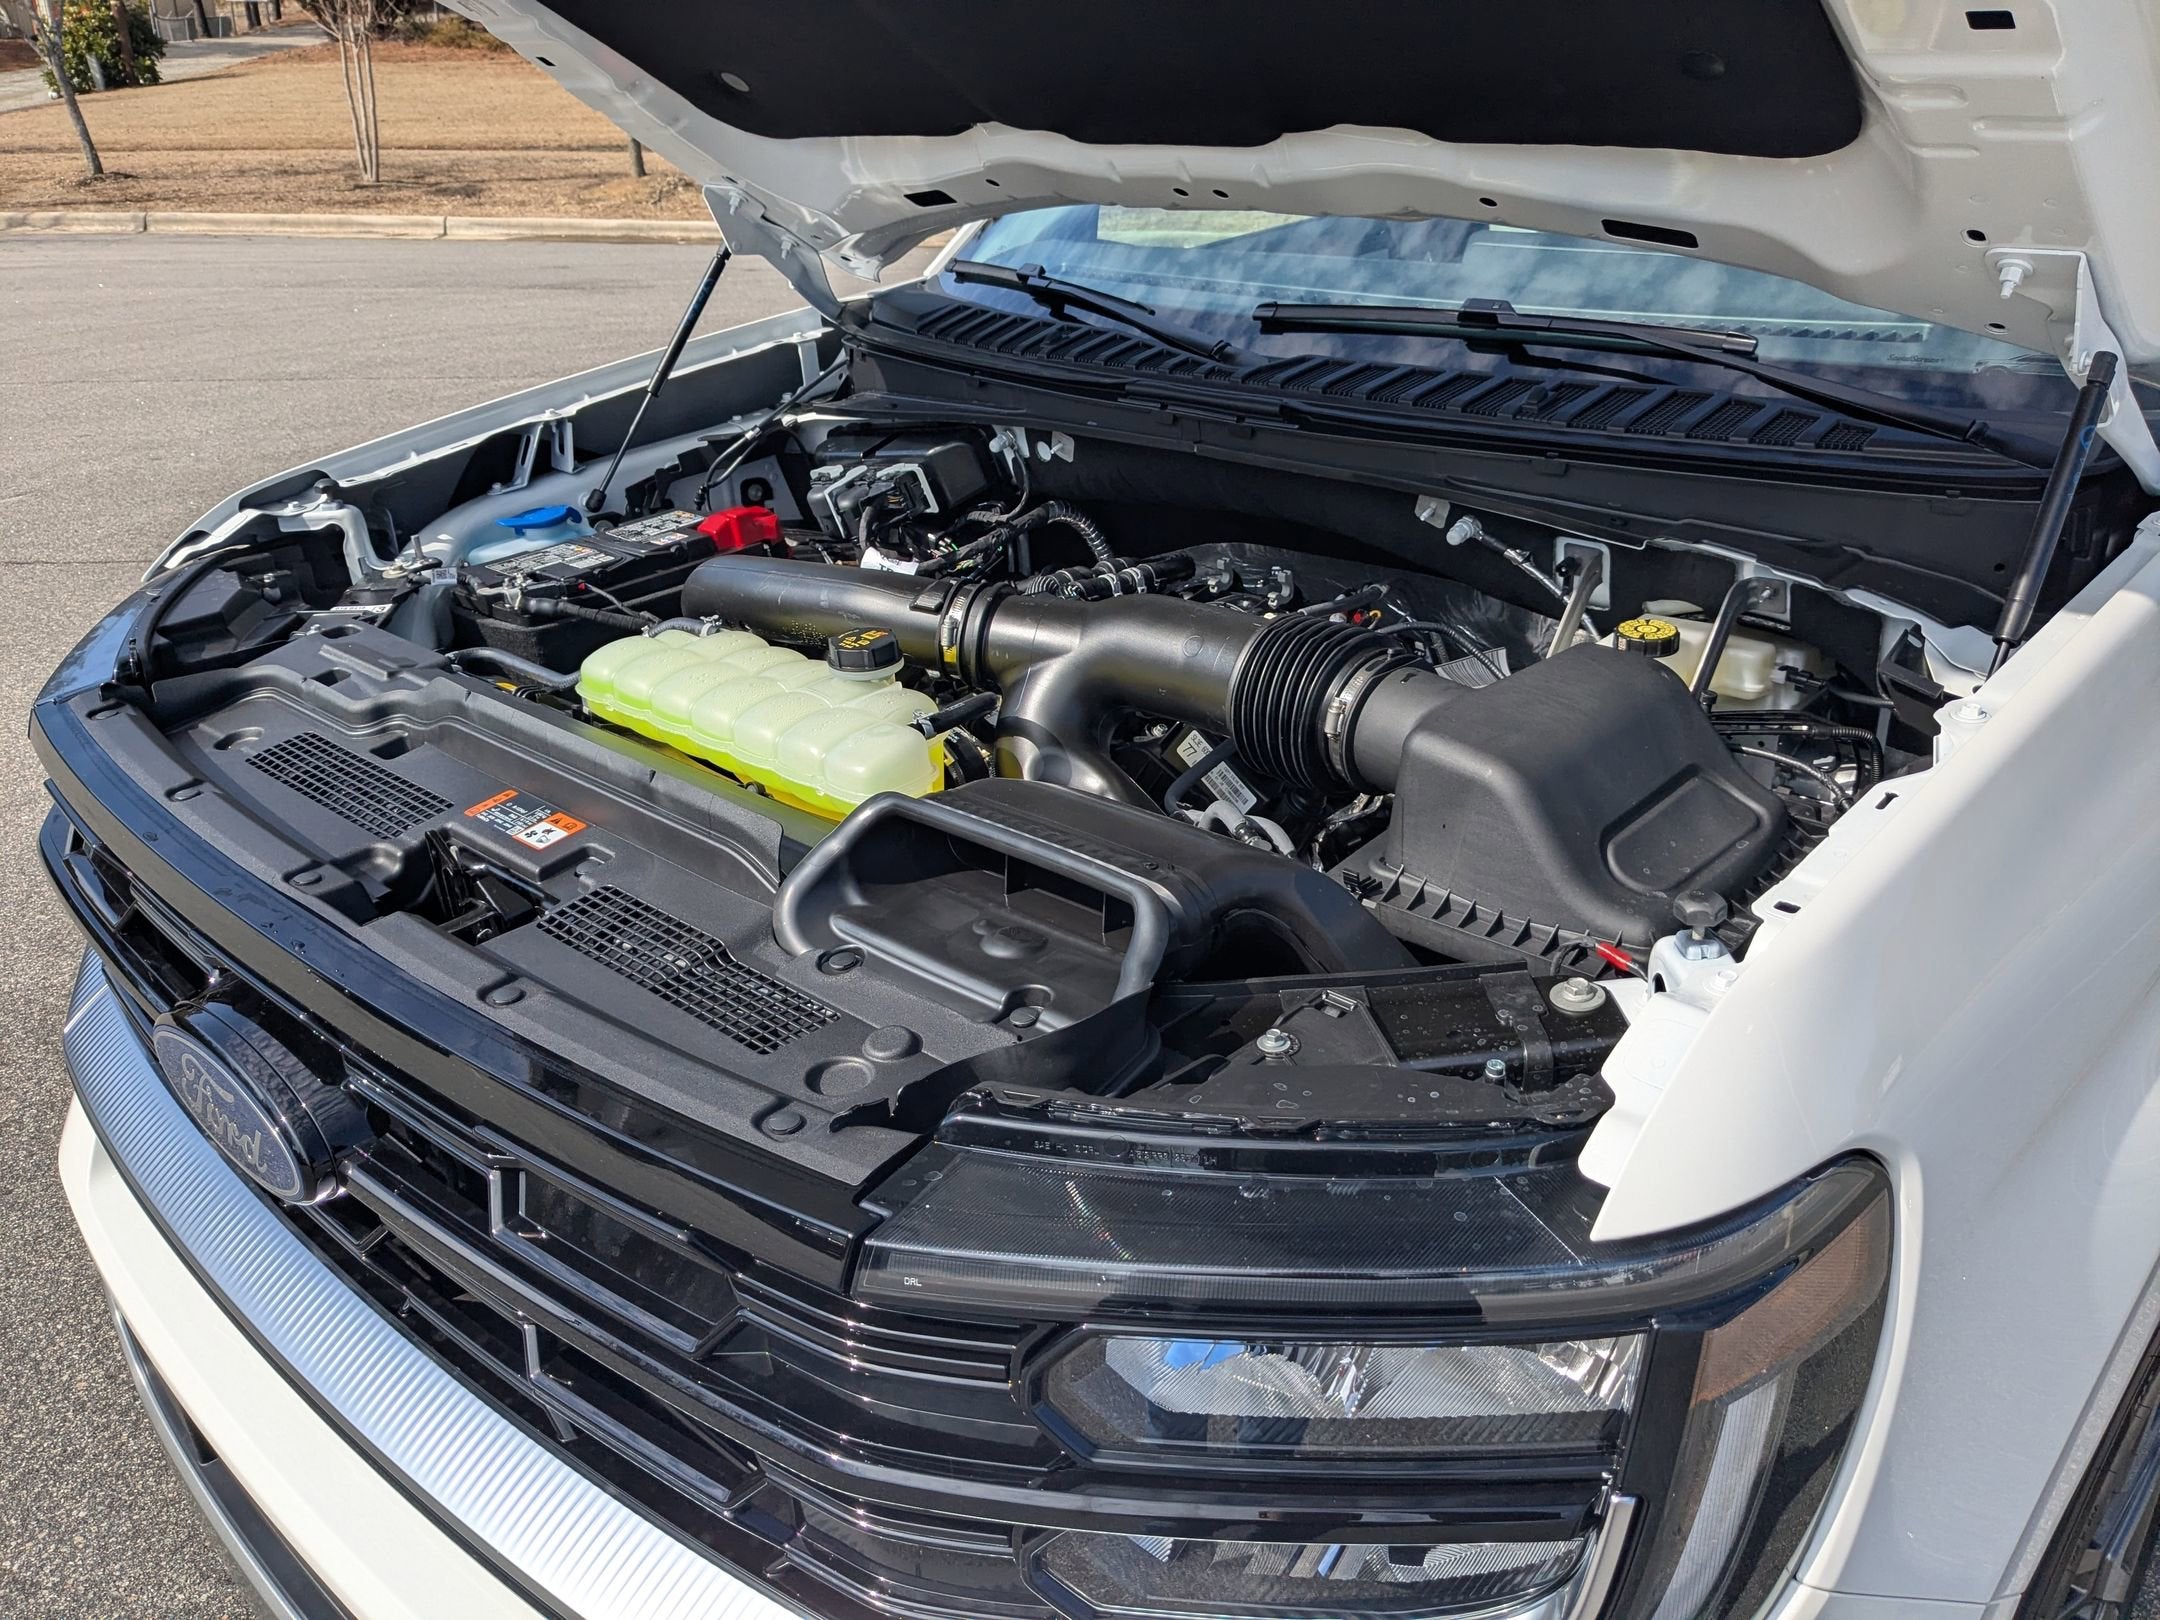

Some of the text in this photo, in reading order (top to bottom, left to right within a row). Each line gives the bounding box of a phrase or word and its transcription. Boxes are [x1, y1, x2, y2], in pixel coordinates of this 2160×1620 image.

[1182, 742, 1198, 757] 77
[181, 1053, 268, 1173] Ford
[903, 1276, 923, 1287] DRL
